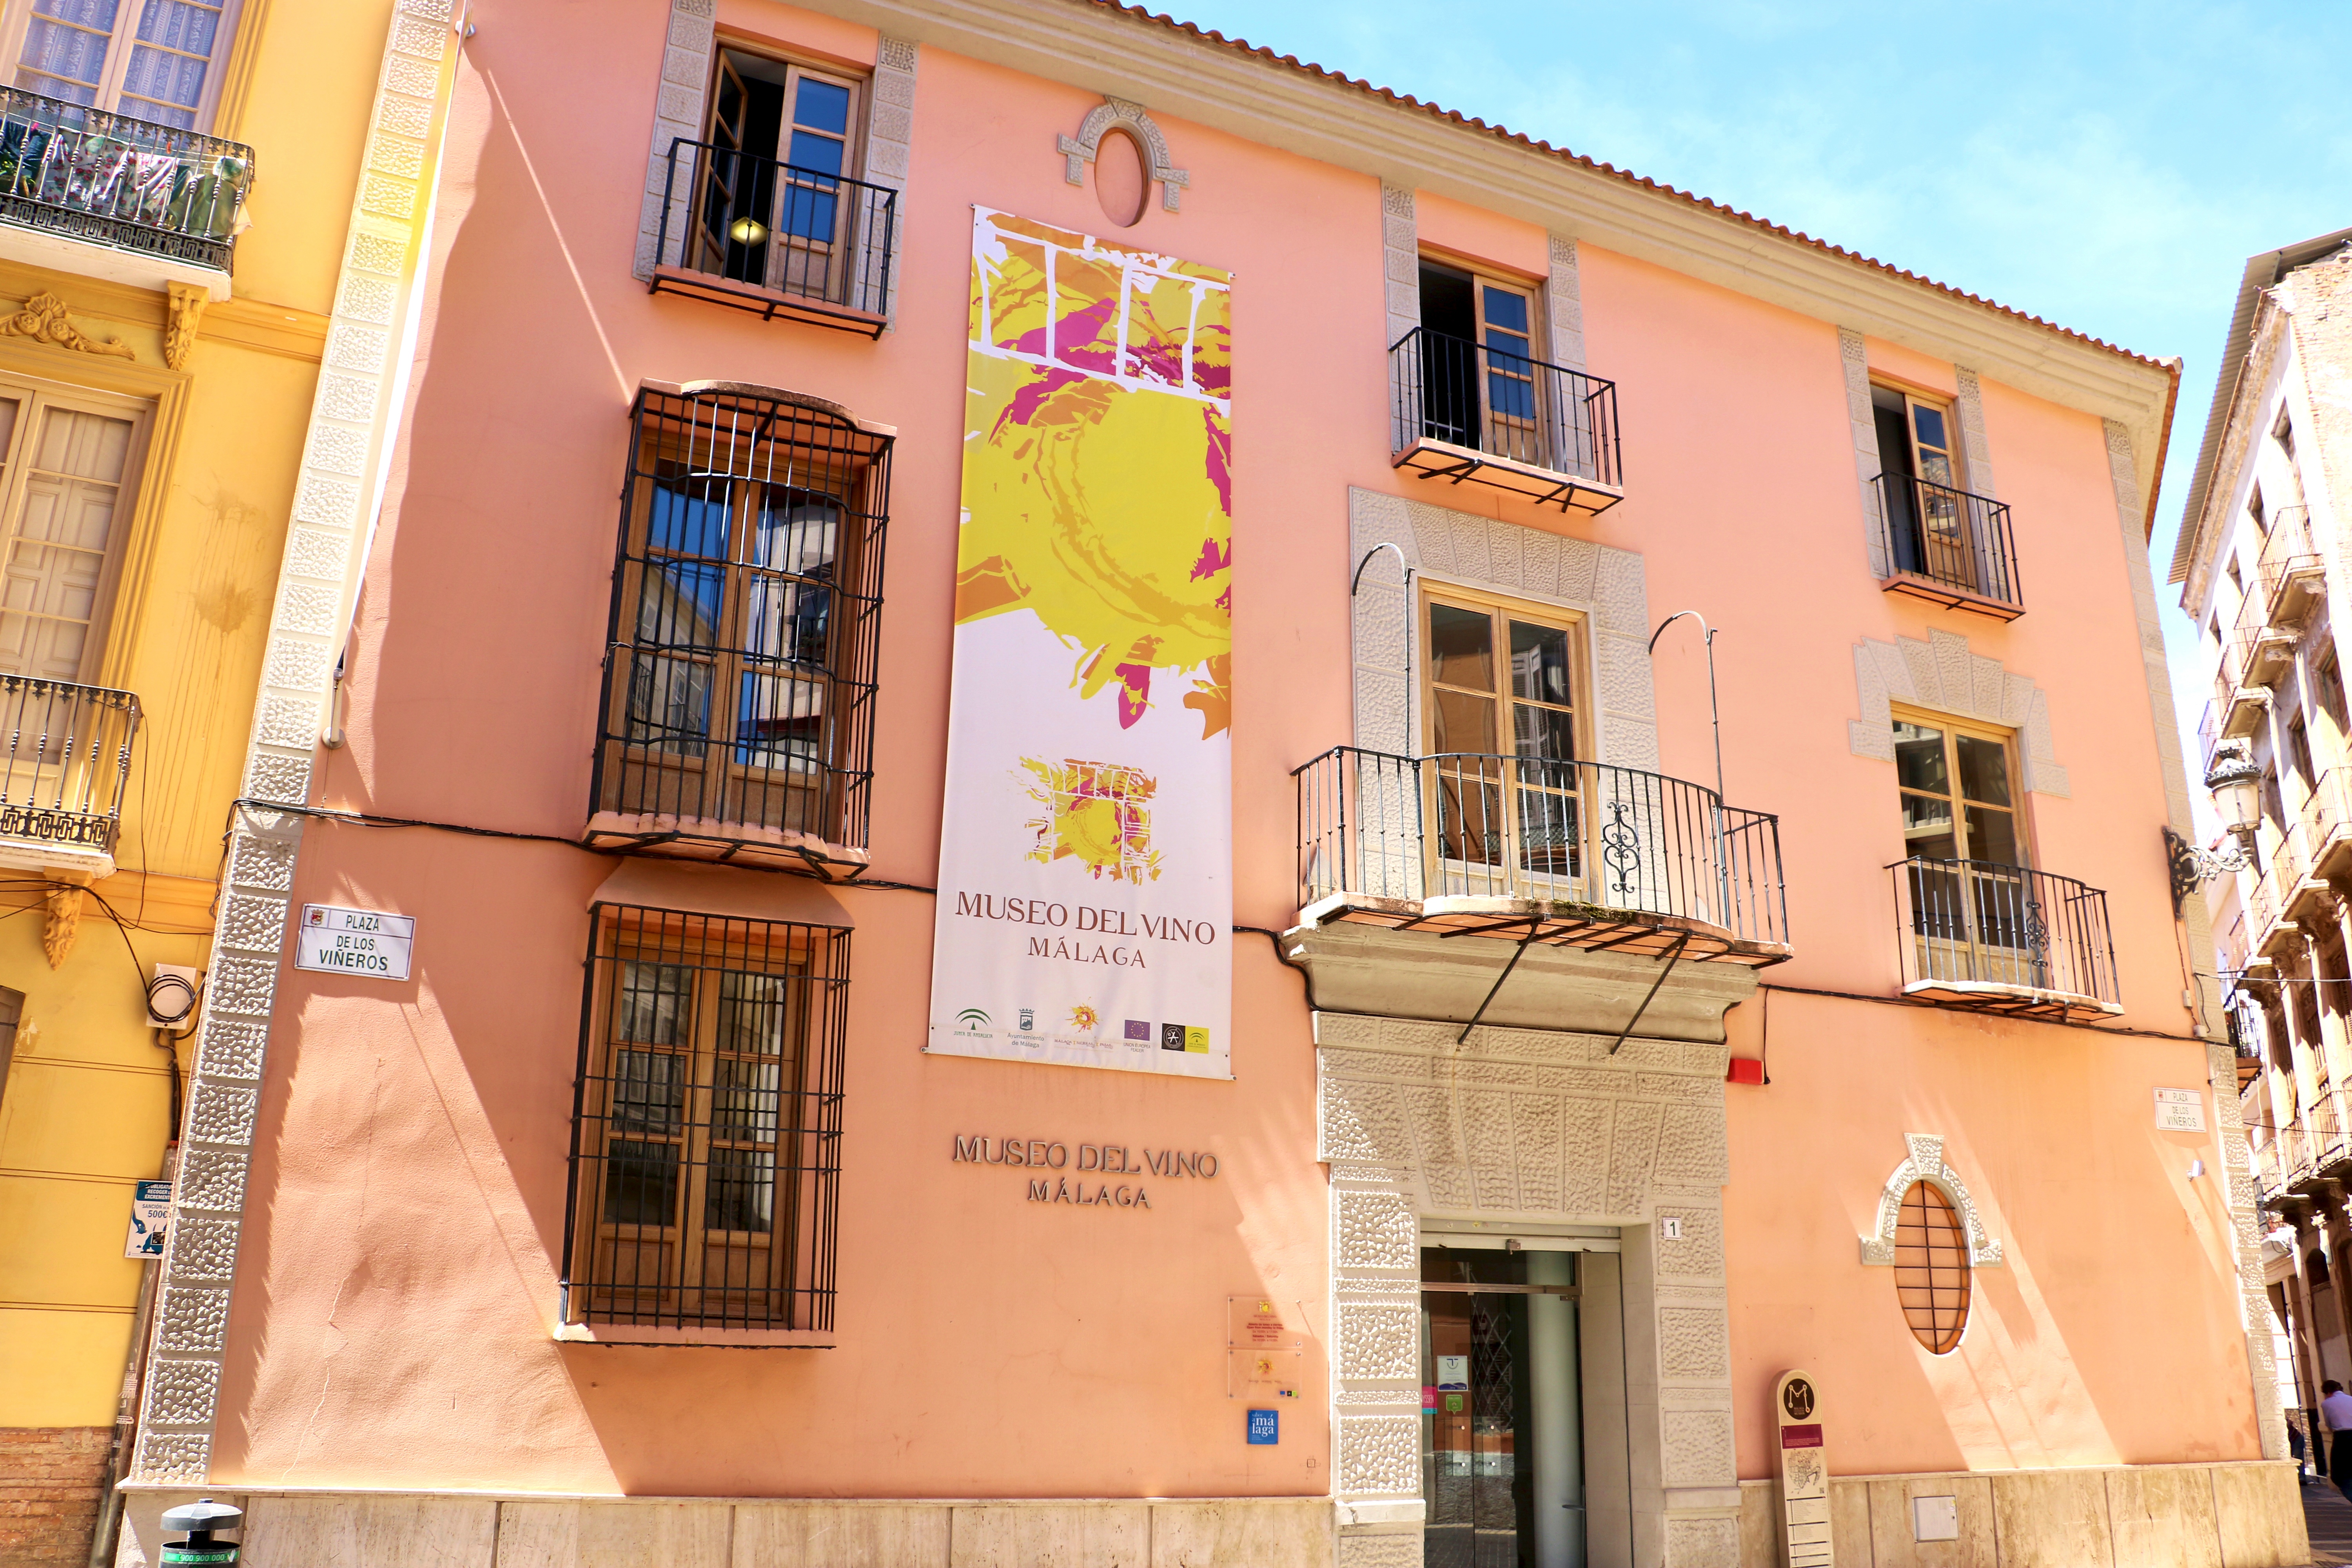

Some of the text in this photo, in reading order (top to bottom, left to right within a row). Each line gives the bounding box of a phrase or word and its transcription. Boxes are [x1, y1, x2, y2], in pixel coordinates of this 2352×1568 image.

[346, 915, 379, 931] PLAZA
[955, 891, 1215, 945] MUSEO DEL VINO
[336, 935, 374, 951] DE LOS
[1028, 935, 1146, 969] MÁLAGA
[319, 949, 388, 971] VIÑEROS
[1007, 1033, 1044, 1041] Ayuntamiento
[2173, 1093, 2188, 1102] PLAZA
[2180, 1107, 2189, 1115] LOS
[2166, 1114, 2197, 1127] VIÑEROS
[953, 1135, 1221, 1178] MUSEO DEL VINO
[1028, 1177, 1152, 1209] MÁLAGA
[147, 1210, 168, 1218] 500€
[1670, 1221, 1675, 1236] 1
[1256, 1414, 1274, 1426] má
[1252, 1423, 1274, 1437] laga
